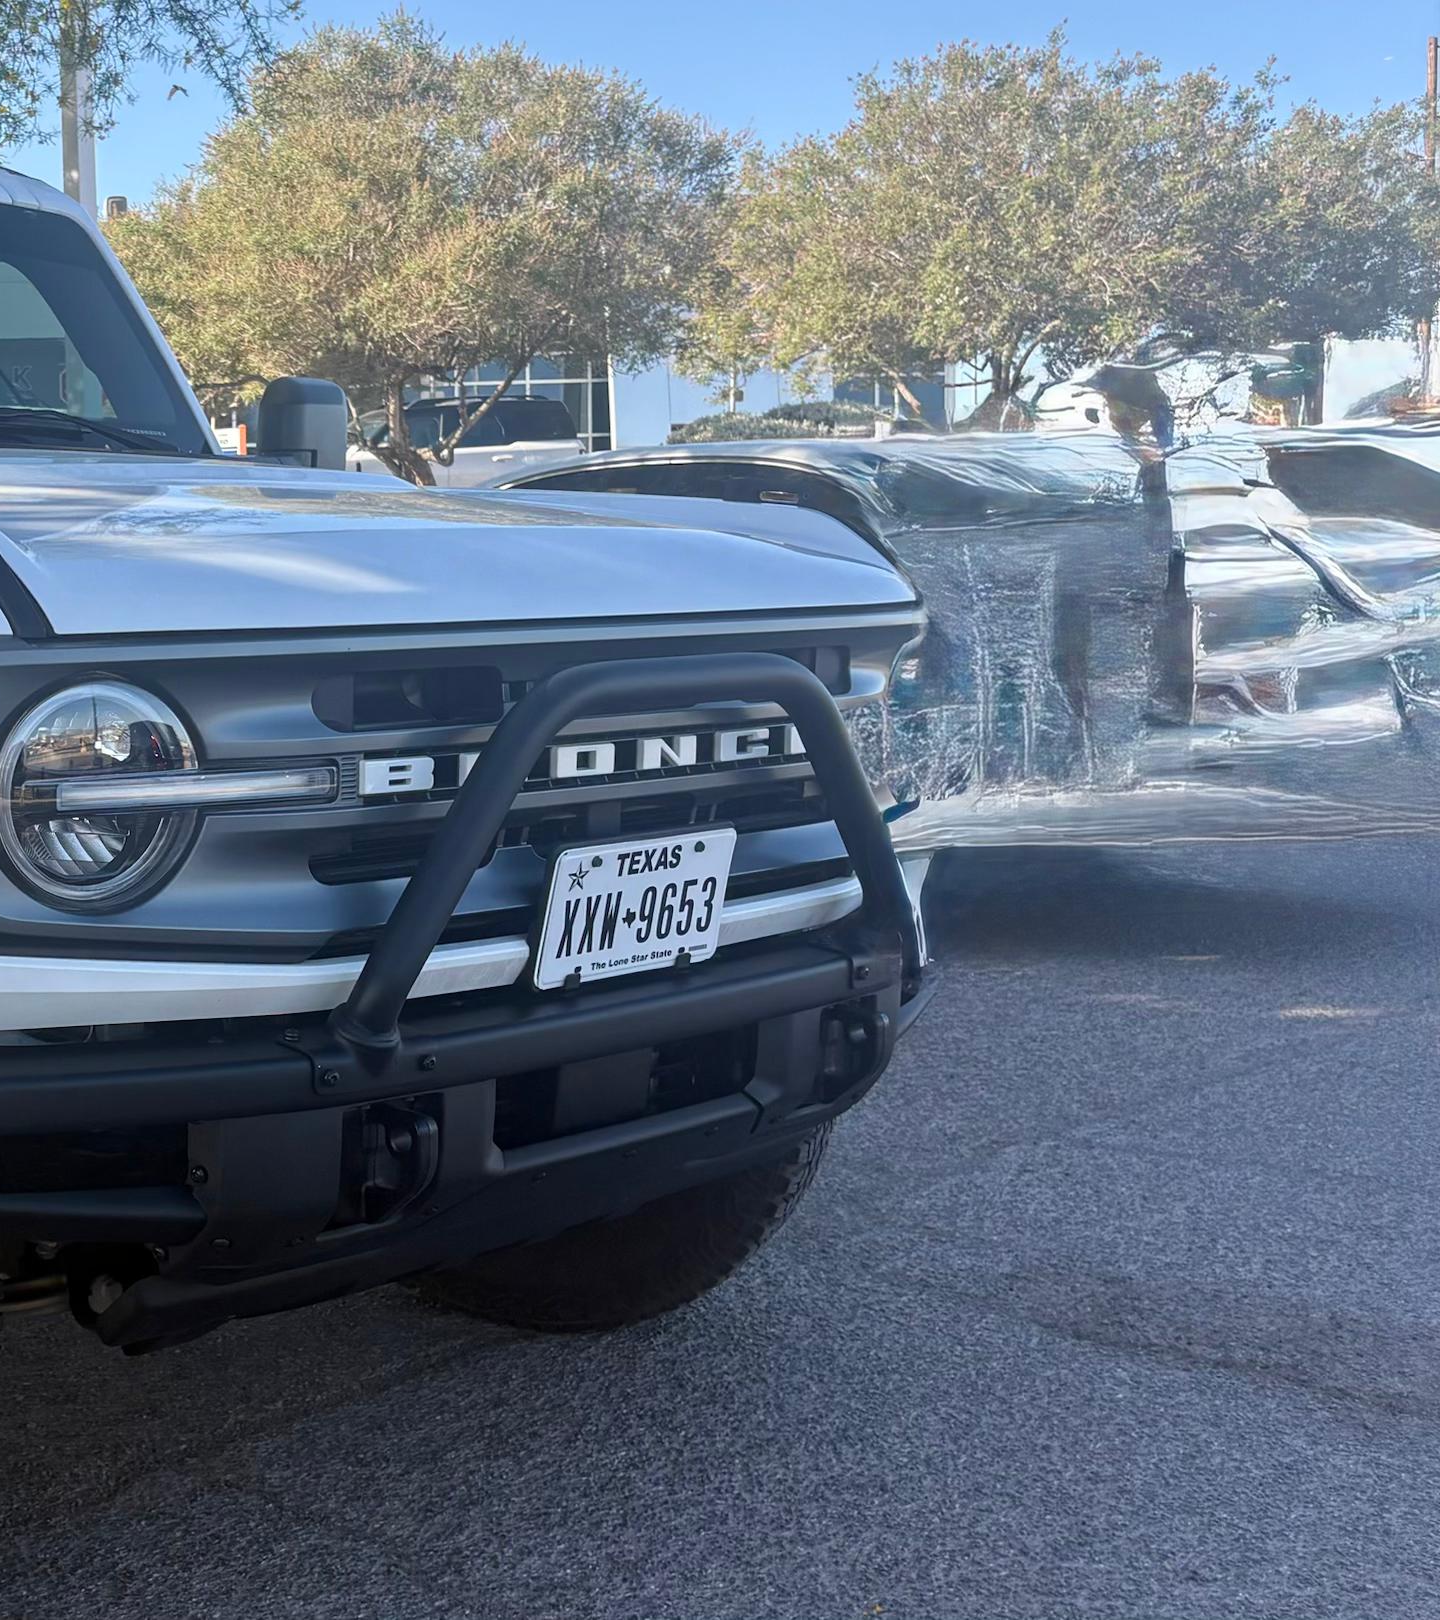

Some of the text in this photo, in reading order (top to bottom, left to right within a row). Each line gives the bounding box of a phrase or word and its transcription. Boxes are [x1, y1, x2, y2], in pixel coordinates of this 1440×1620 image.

[360, 722, 807, 795] BONC
[616, 844, 683, 877] TEXAS
[591, 950, 673, 971] The Lone Star State
